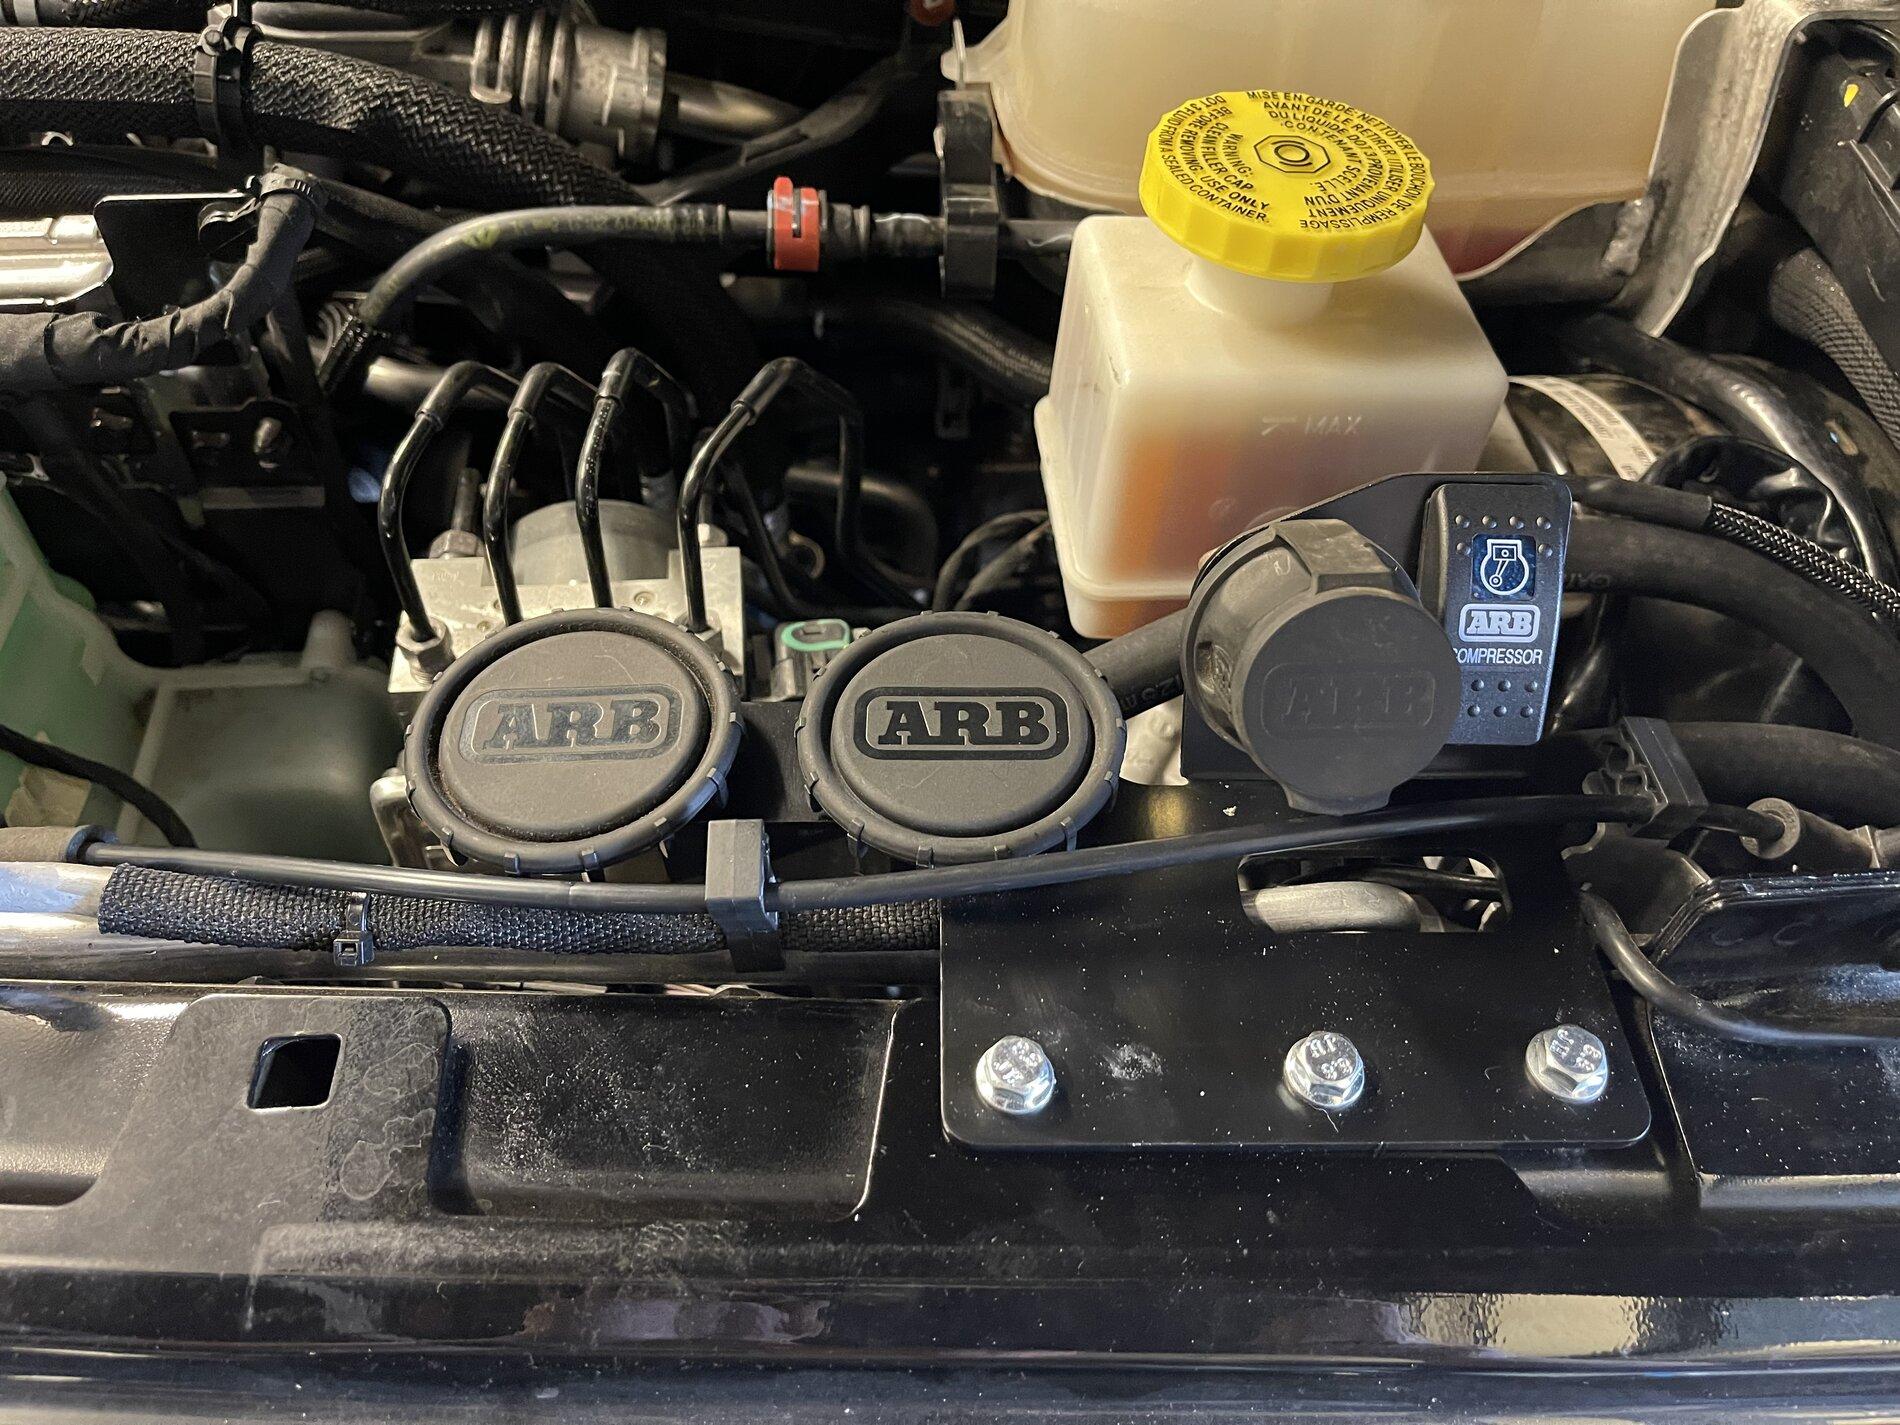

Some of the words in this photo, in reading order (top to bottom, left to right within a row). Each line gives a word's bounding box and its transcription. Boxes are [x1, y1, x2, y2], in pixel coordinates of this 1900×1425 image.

[1199, 95, 1227, 108] DOT
[1246, 91, 1280, 100] MISE
[1283, 92, 1302, 102] EN
[1167, 106, 1196, 126] FLUID
[1190, 103, 1202, 111] 3
[1263, 101, 1310, 112] AVANT
[1268, 110, 1289, 119] DU
[1312, 107, 1332, 118] DE
[1188, 106, 1233, 130] BEFORE
[1292, 113, 1349, 135] LIQUIDE
[1333, 114, 1354, 126] LE
[1158, 124, 1178, 146] FROM
[1202, 122, 1229, 145] CLEAN
[1284, 120, 1362, 164] CONTENANT
[1346, 134, 1373, 150] DOT
[1357, 113, 1414, 150] NETTOYER
[1201, 146, 1228, 174] FILLER
[1222, 133, 1254, 178] WARNING:
[1404, 151, 1423, 162] LE
[1161, 154, 1195, 185] SEALED
[1341, 157, 1383, 202] PROVENANT
[1385, 158, 1404, 193] UTILISER
[1200, 175, 1230, 193] USE
[1223, 174, 1254, 191] CAP
[1402, 162, 1426, 200] BOUCHON
[1189, 184, 1270, 223] CONTAINER.
[1228, 191, 1271, 210] ONLY
[1304, 193, 1341, 206] D'UN
[1308, 190, 1392, 218] UNIQUEMENT
[1390, 198, 1413, 211] DE
[1299, 207, 1398, 229] REMPLISSAGE
[1304, 415, 1362, 435] MAX
[1466, 610, 1533, 636] ARB
[1453, 648, 1543, 665] OMPRESSOR
[484, 699, 661, 750] ARB
[877, 701, 1051, 745] ARB
